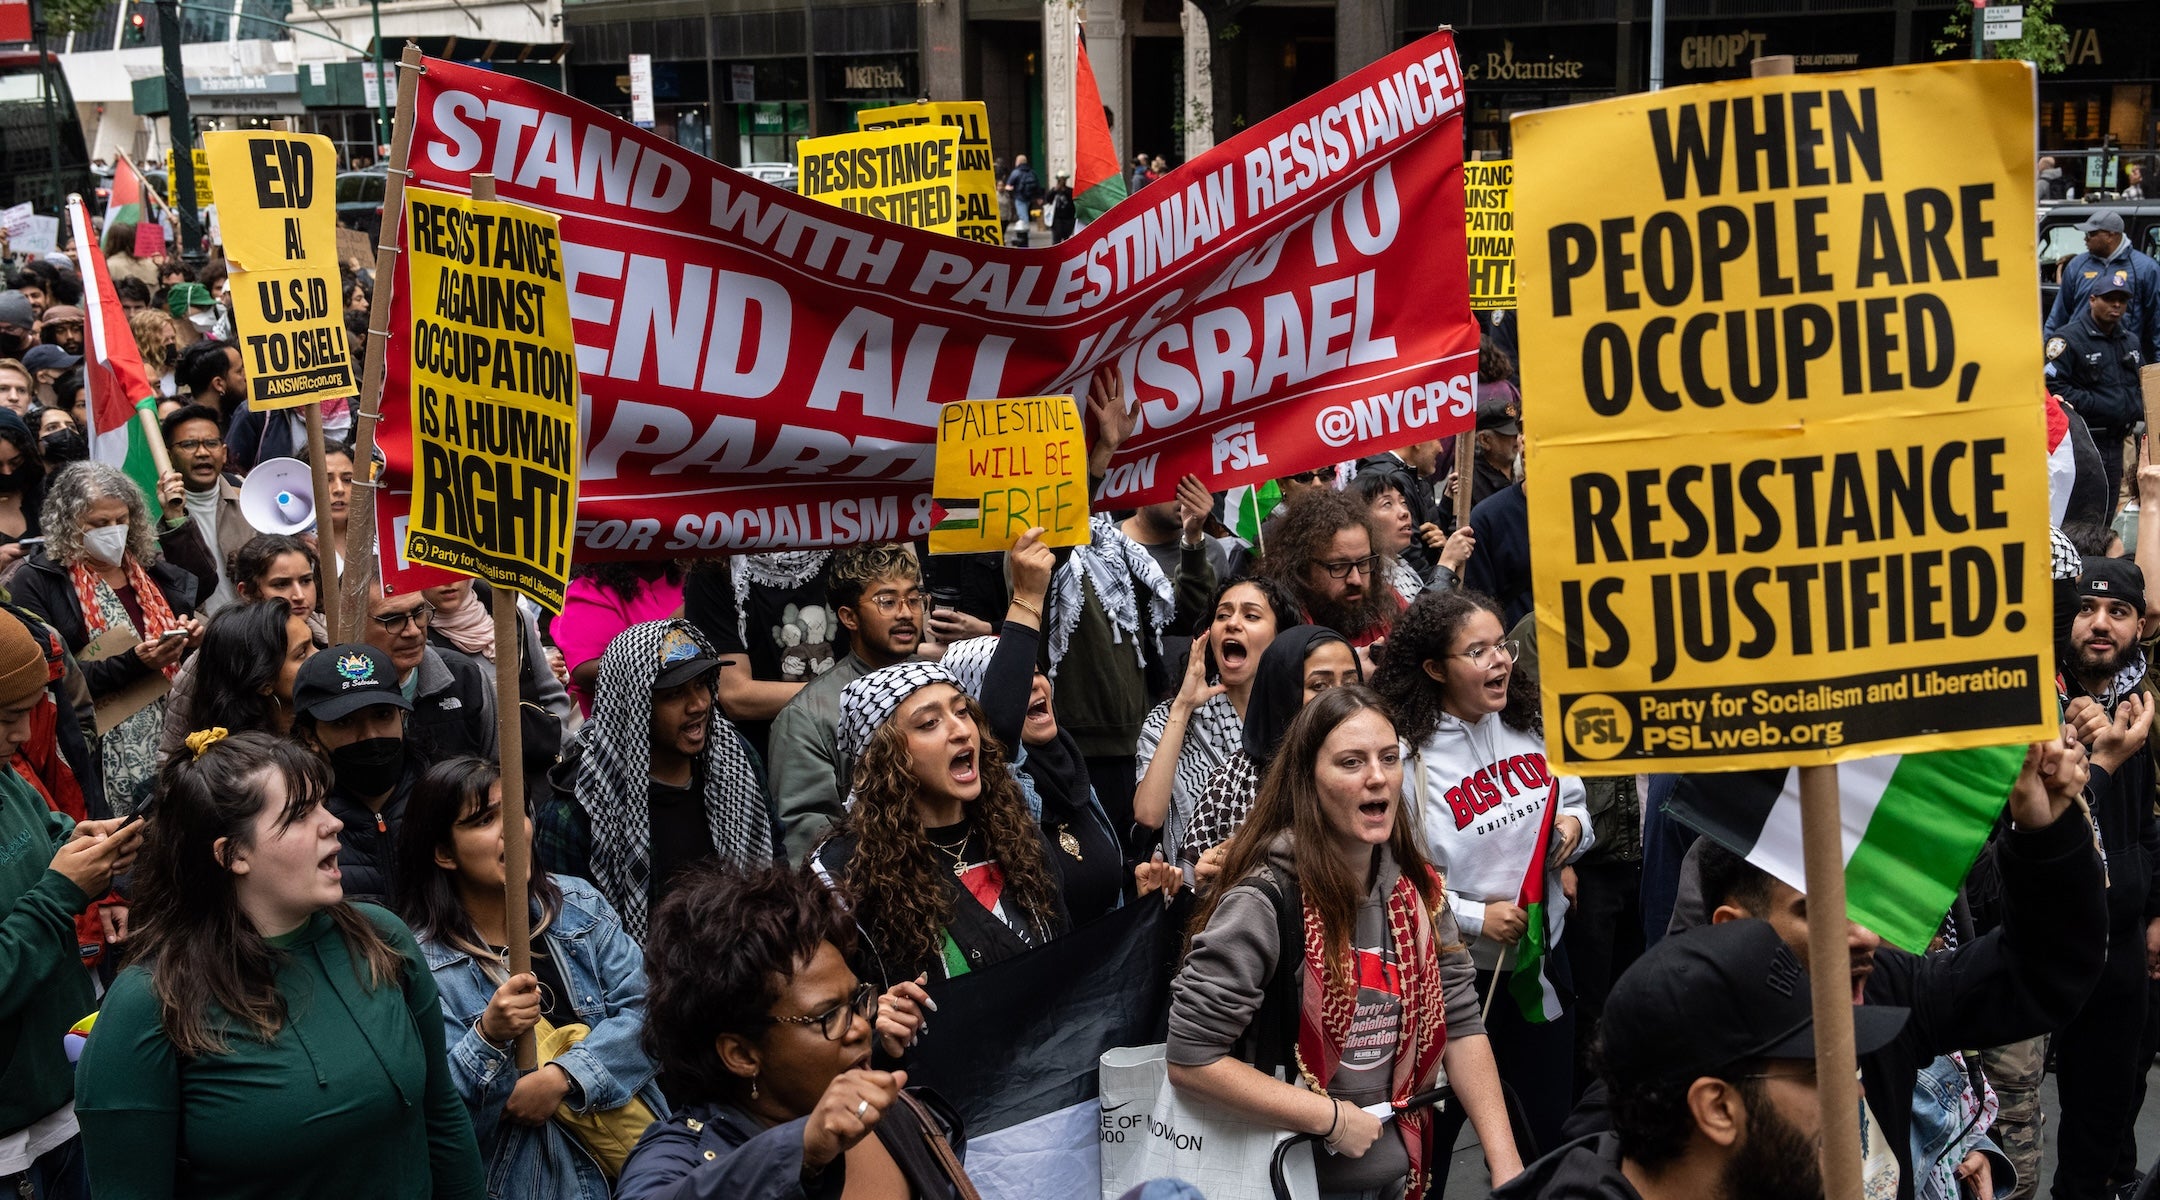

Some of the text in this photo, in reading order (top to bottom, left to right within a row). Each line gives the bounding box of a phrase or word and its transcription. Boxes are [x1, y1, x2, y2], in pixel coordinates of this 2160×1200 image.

[845, 64, 905, 89] M&T Bank
[1486, 52, 1583, 80] Botaniste
[803, 139, 954, 196] RESISTANCE
[1647, 87, 1884, 201] WHEN
[427, 46, 1464, 317] STAND WITH PALESTINIAN RESISTANCE!
[411, 201, 562, 283] RESISTANCE
[1547, 182, 1999, 318] PEOPLE ARE
[435, 265, 546, 338] AGAINST
[561, 240, 793, 399] END
[246, 332, 290, 375] TO
[414, 318, 574, 407] OCCUPATION
[1581, 292, 1982, 418] OCCUPIED,
[418, 384, 572, 476] IS A HUMAN
[942, 400, 1075, 442] PALESTINE
[969, 440, 1073, 479] WILL BE
[1212, 430, 1269, 476] PSL
[421, 438, 570, 577] RIGHT!
[664, 495, 898, 551] SOCIALISM
[908, 493, 934, 537] &
[979, 481, 1074, 539] FREE
[1570, 437, 2009, 565] RESISTANCE
[430, 545, 460, 565] Party
[460, 553, 475, 567] for
[475, 556, 517, 582] Socialism
[519, 573, 533, 588] and
[533, 577, 563, 606] Liberation
[1560, 541, 2028, 684] IS JUSTIFIED!
[1640, 666, 2028, 725] Party for Socialism and Liberation
[1573, 715, 1625, 746] PSL
[1642, 718, 1844, 753] PSLweb.org
[1443, 753, 1553, 832] BOSTON
[1345, 1030, 1399, 1049] iberation
[1351, 1014, 1399, 1034] ocialism
[1118, 1114, 1142, 1129] OF
